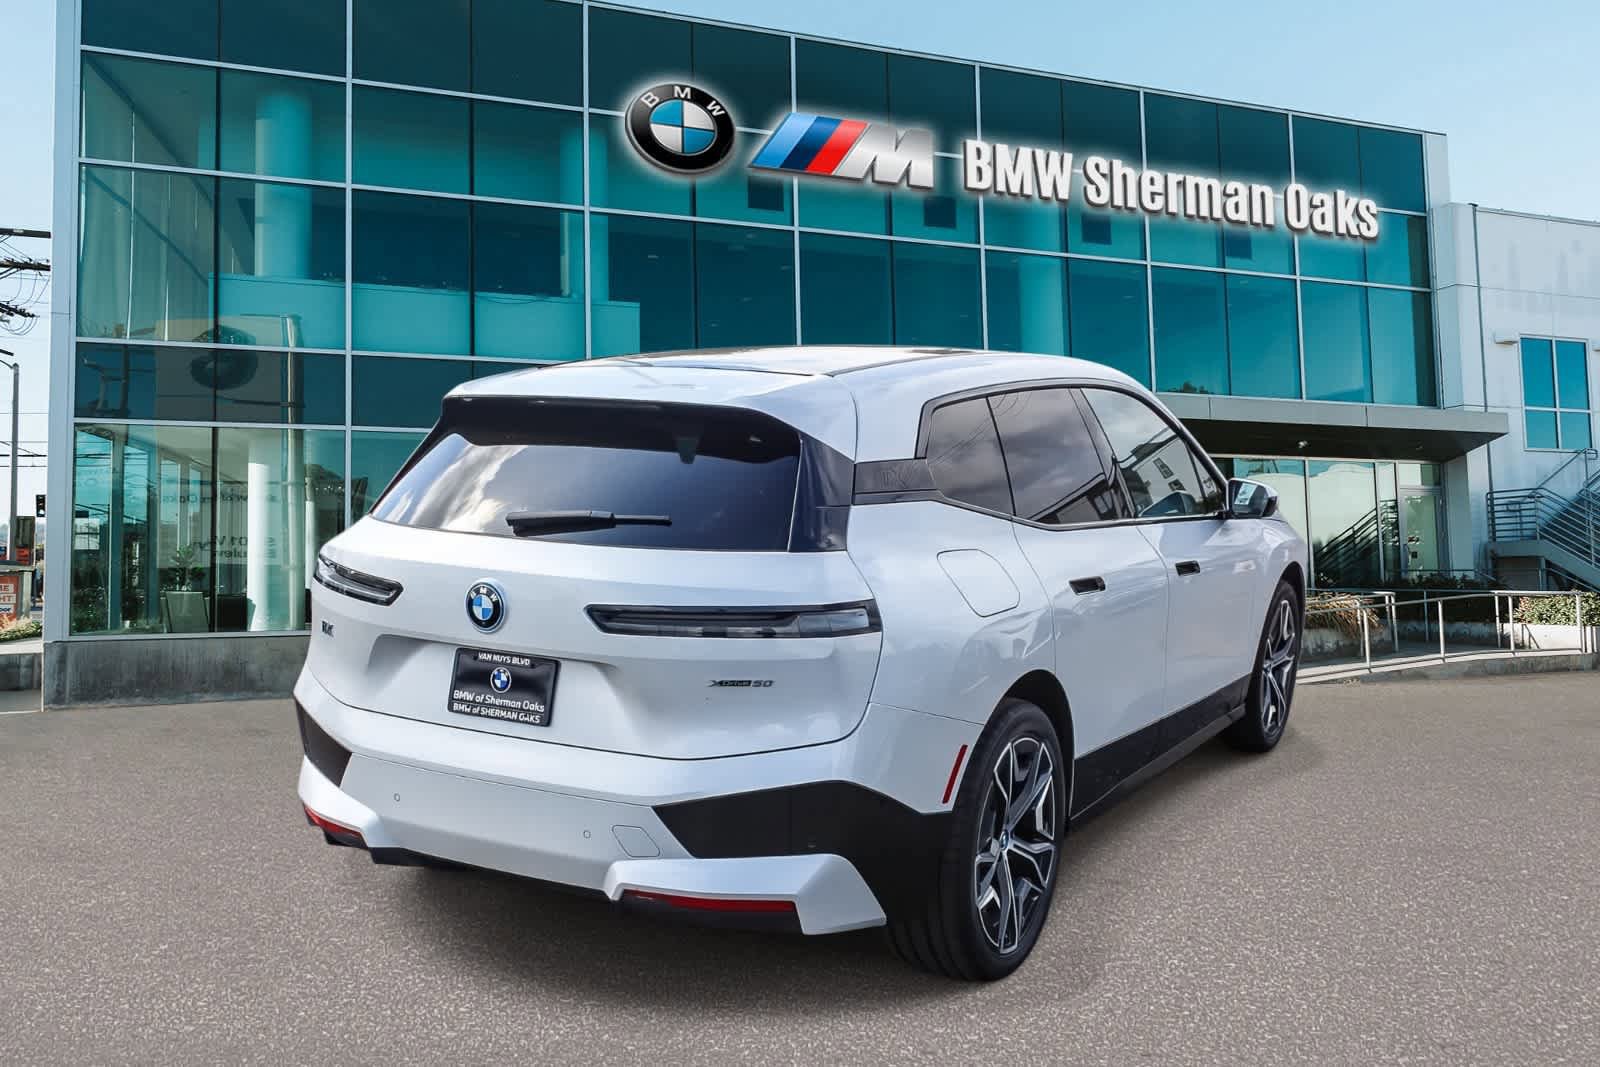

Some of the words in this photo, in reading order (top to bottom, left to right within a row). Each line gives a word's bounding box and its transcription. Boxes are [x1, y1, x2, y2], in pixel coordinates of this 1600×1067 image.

[641, 85, 726, 117] BMW
[964, 139, 1073, 200] BMW
[1083, 156, 1275, 226] Sherman
[1282, 182, 1380, 240] Oaks
[478, 652, 492, 661] VAN
[493, 654, 511, 664] NUYS
[511, 656, 531, 666] BLVD
[453, 689, 474, 701] BMW
[475, 693, 485, 703] of
[484, 694, 522, 710] Sherman
[522, 700, 545, 713] Oaks
[453, 702, 473, 713] BMW
[472, 705, 480, 714] of
[480, 707, 518, 720] SHERMAN
